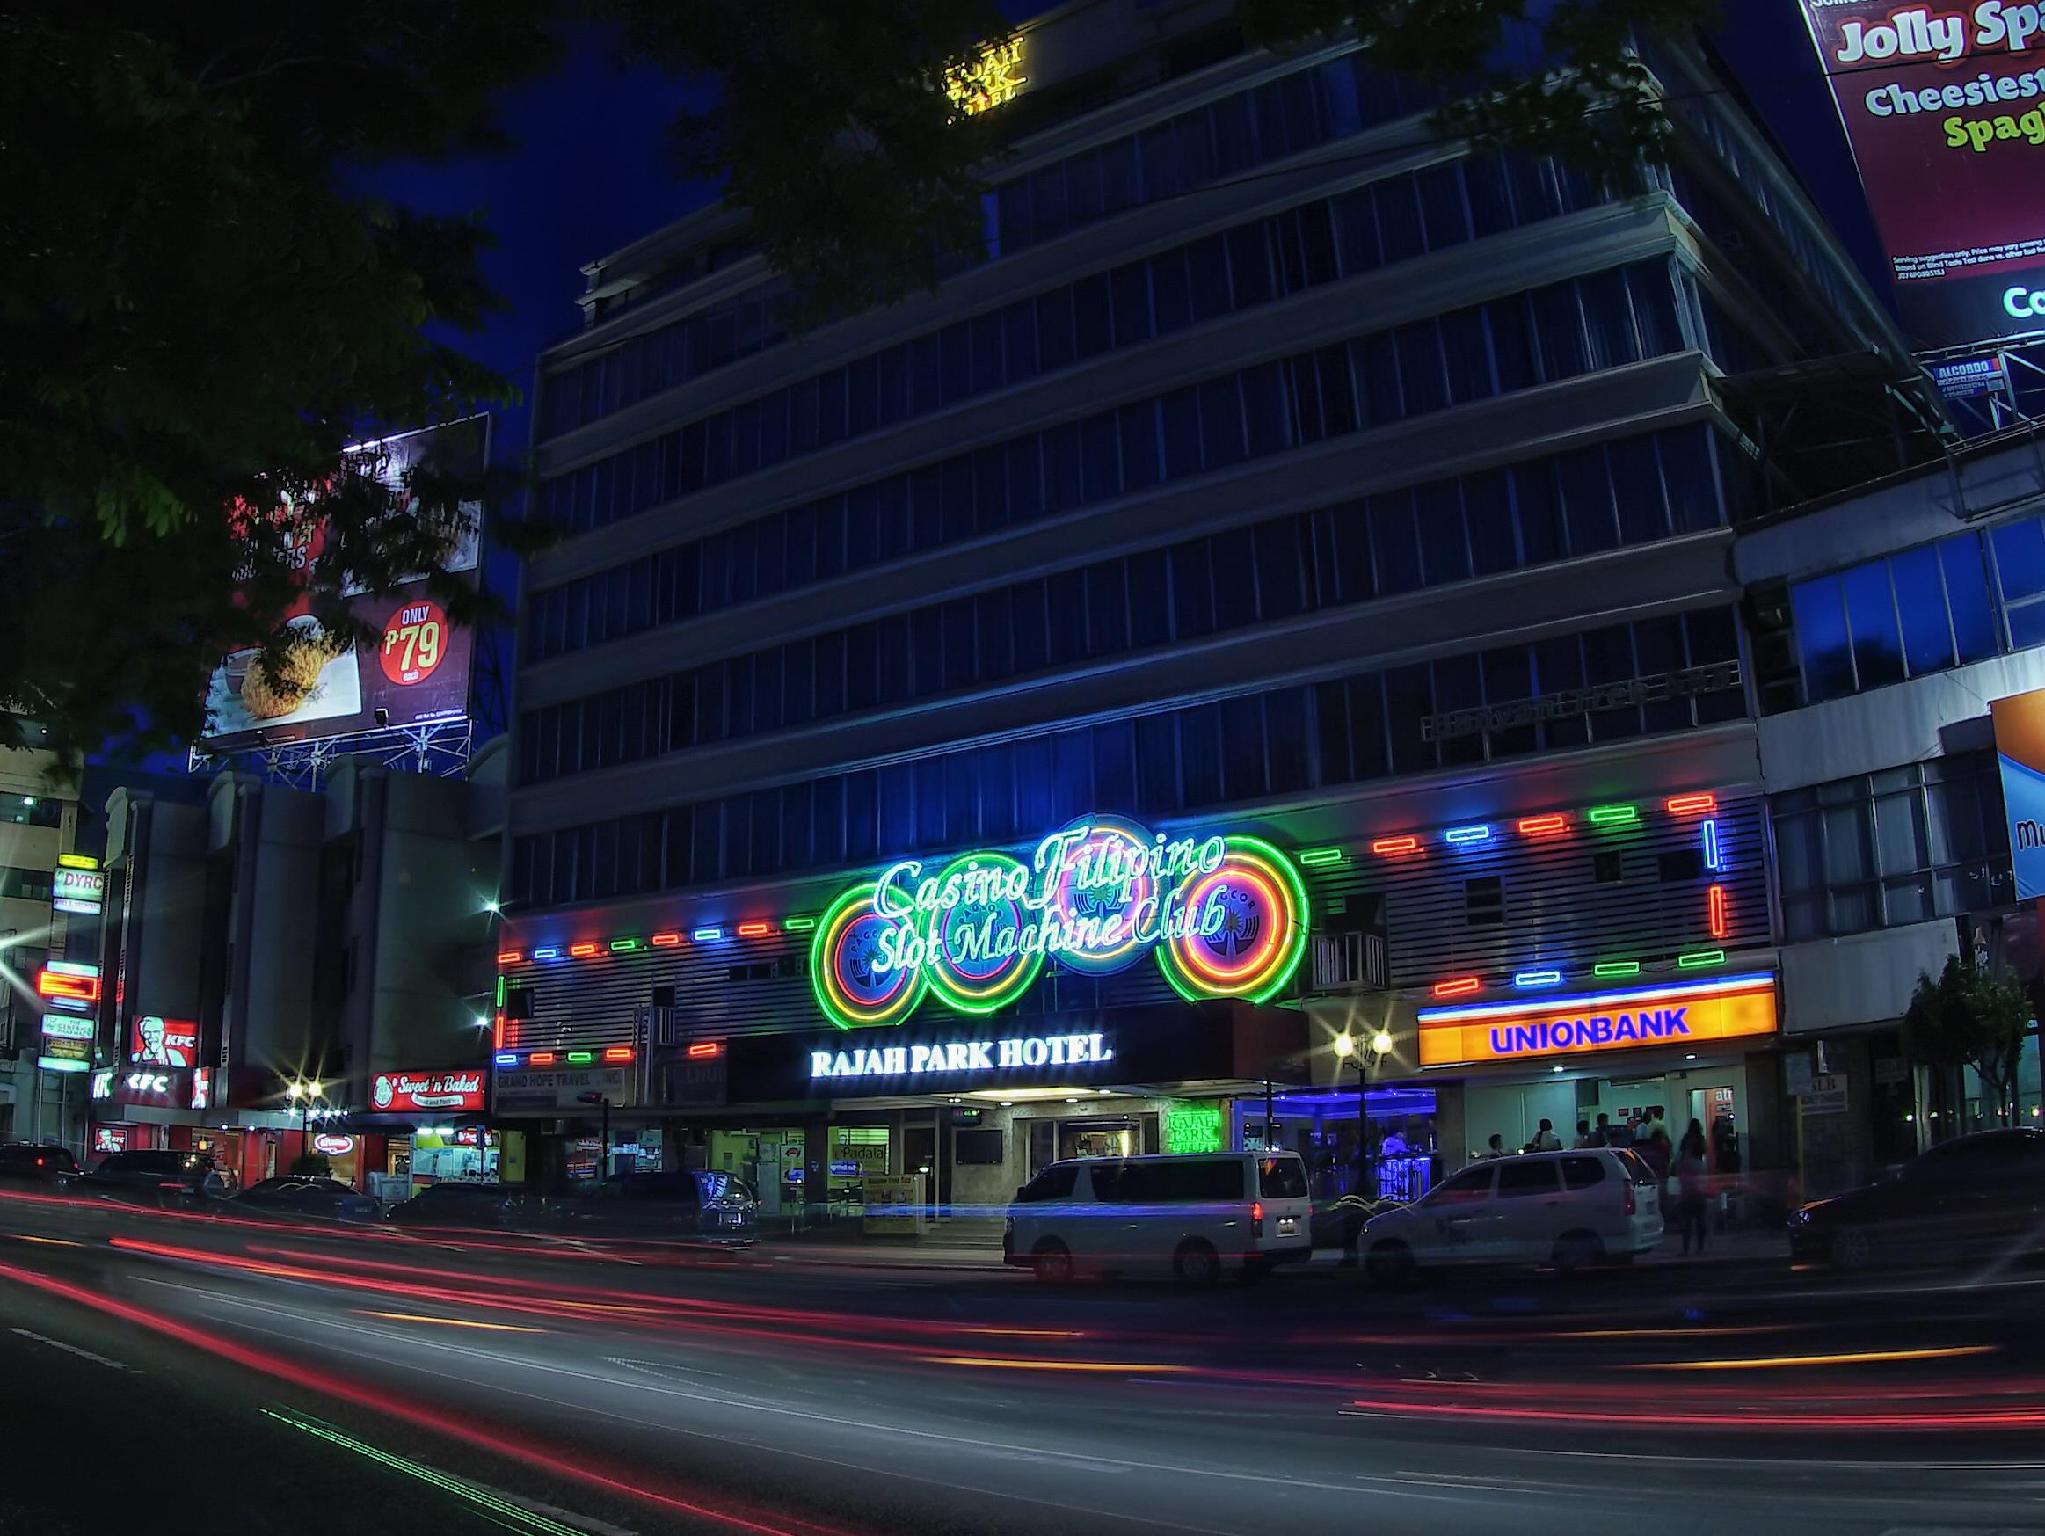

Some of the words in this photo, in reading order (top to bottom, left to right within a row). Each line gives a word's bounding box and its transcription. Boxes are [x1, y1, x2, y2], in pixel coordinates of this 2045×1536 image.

[1837, 10, 1963, 63] Jolly
[1974, 0, 2045, 51] Sp
[402, 605, 431, 625] ONLY
[872, 860, 1030, 919] Casino
[1026, 825, 1227, 909] Filipino
[872, 914, 943, 974] Slot
[953, 904, 1122, 964] Machine
[1131, 885, 1229, 944] Club
[165, 1034, 196, 1048] KFC
[1491, 1007, 1690, 1054] UNIONBANK
[810, 1047, 907, 1078] RAJAH
[910, 1042, 994, 1074] PARK
[998, 1033, 1113, 1067] HOTEL
[127, 1073, 169, 1093] KFC
[443, 1074, 480, 1093] Baked
[842, 1146, 884, 1160] Padala
